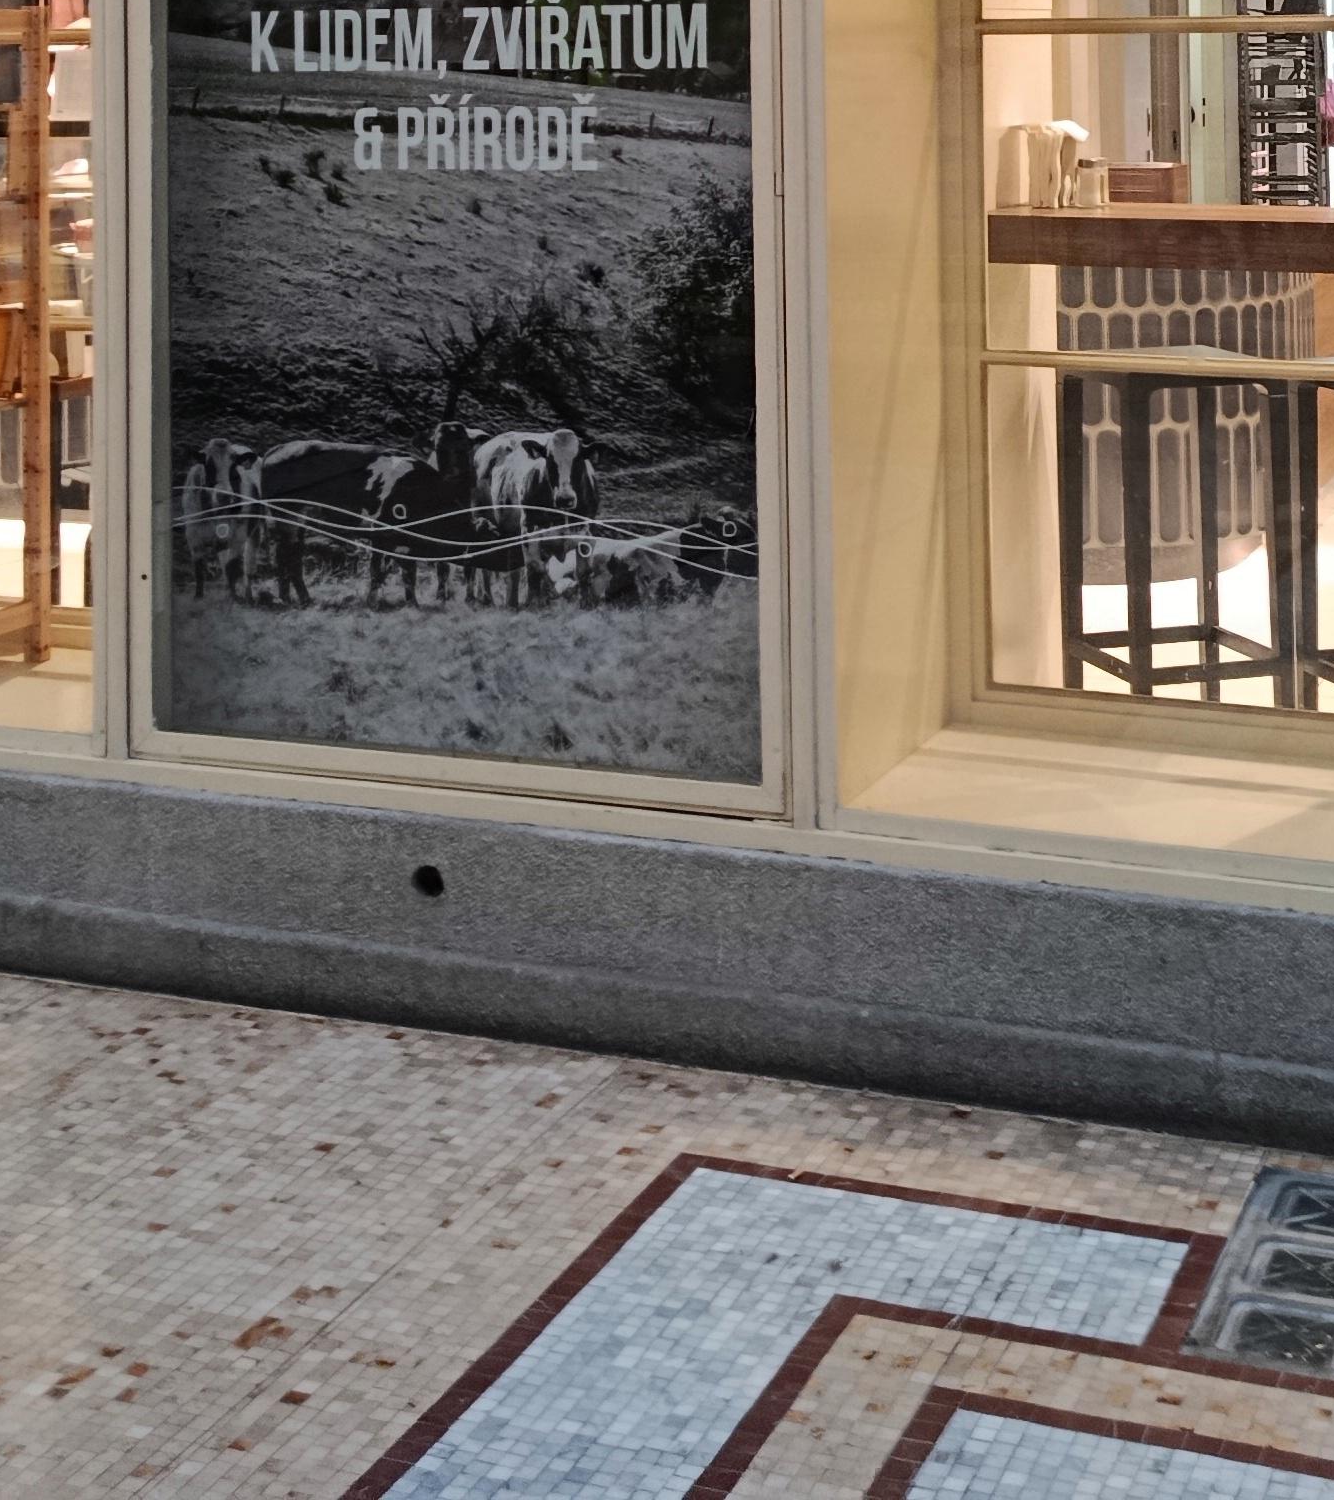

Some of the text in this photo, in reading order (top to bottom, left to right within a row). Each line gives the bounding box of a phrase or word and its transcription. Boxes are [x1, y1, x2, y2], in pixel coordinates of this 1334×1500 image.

[251, 11, 279, 73] K
[294, 8, 447, 80] LIDEM,
[354, 92, 598, 172] & PŘÍRODĚ
